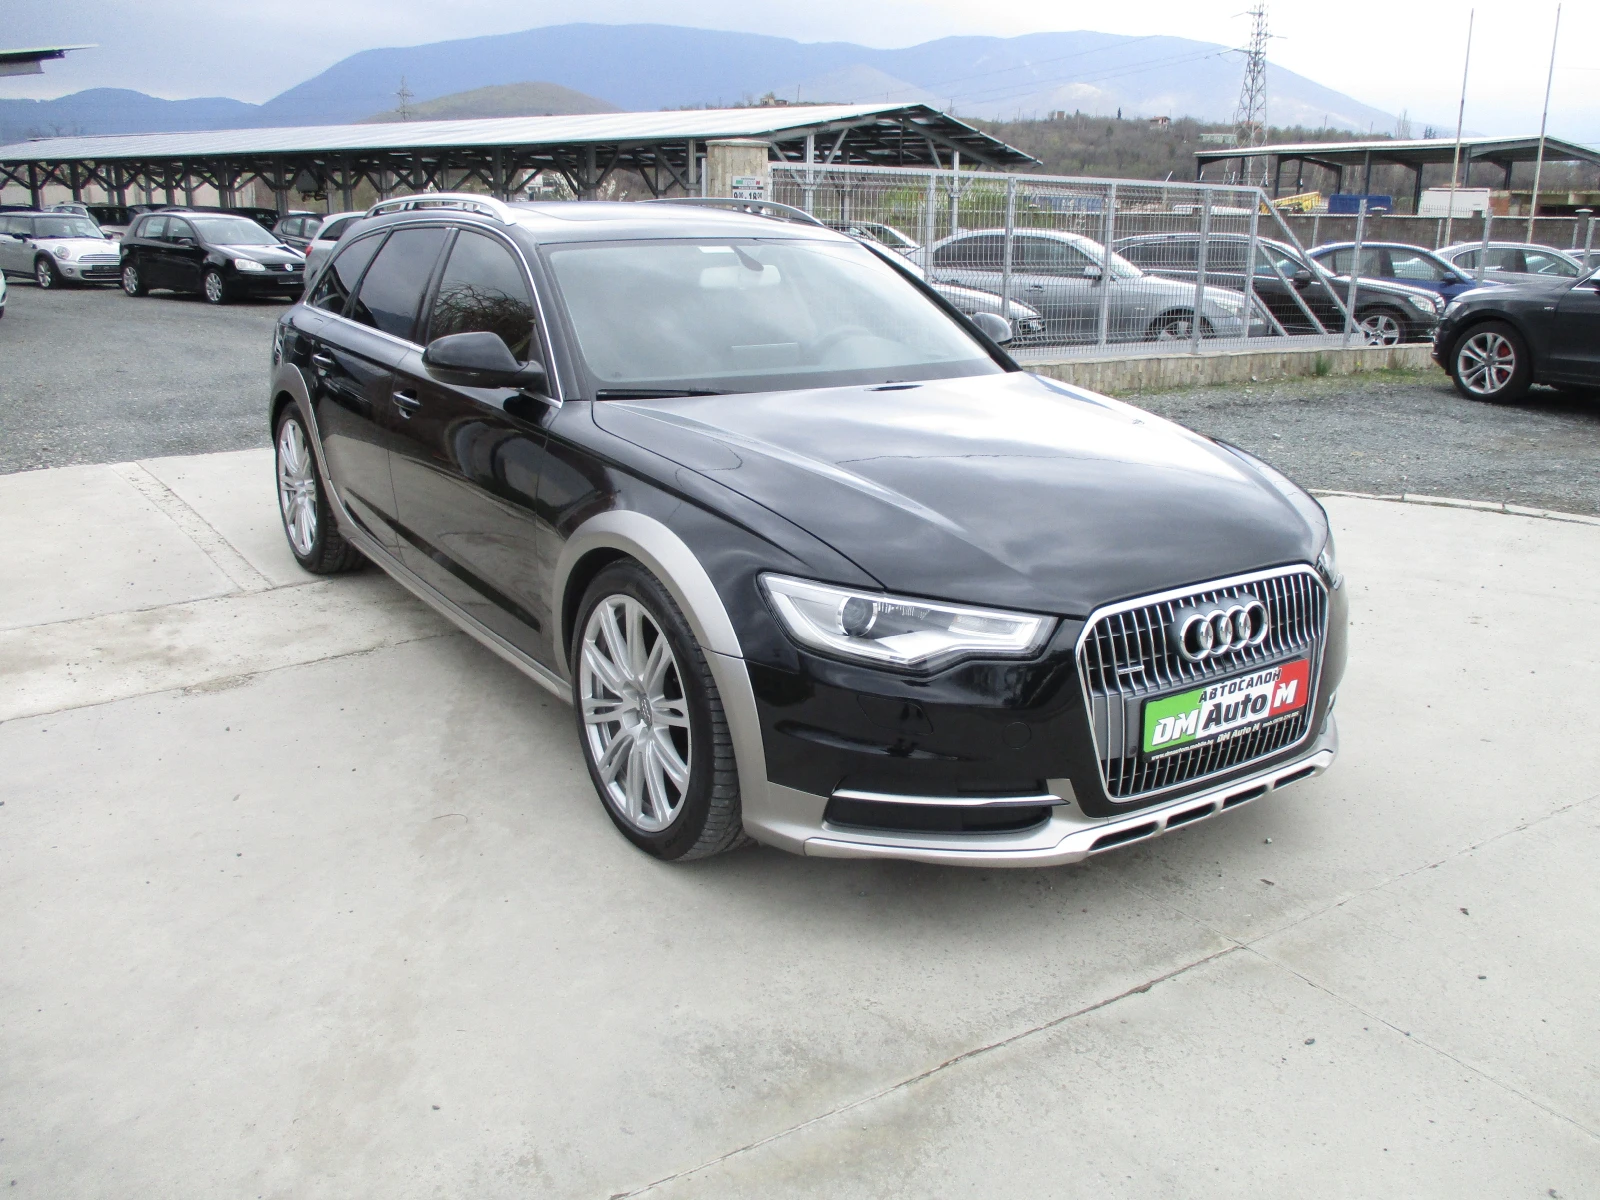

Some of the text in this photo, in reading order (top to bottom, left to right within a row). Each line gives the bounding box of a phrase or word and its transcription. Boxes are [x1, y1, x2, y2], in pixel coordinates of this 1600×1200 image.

[1199, 667, 1282, 703] АВТОСАЛОН
[1152, 709, 1200, 746] DM
[1202, 693, 1269, 731] Auto
[1273, 680, 1298, 708] M
[1231, 726, 1252, 738] Auto
